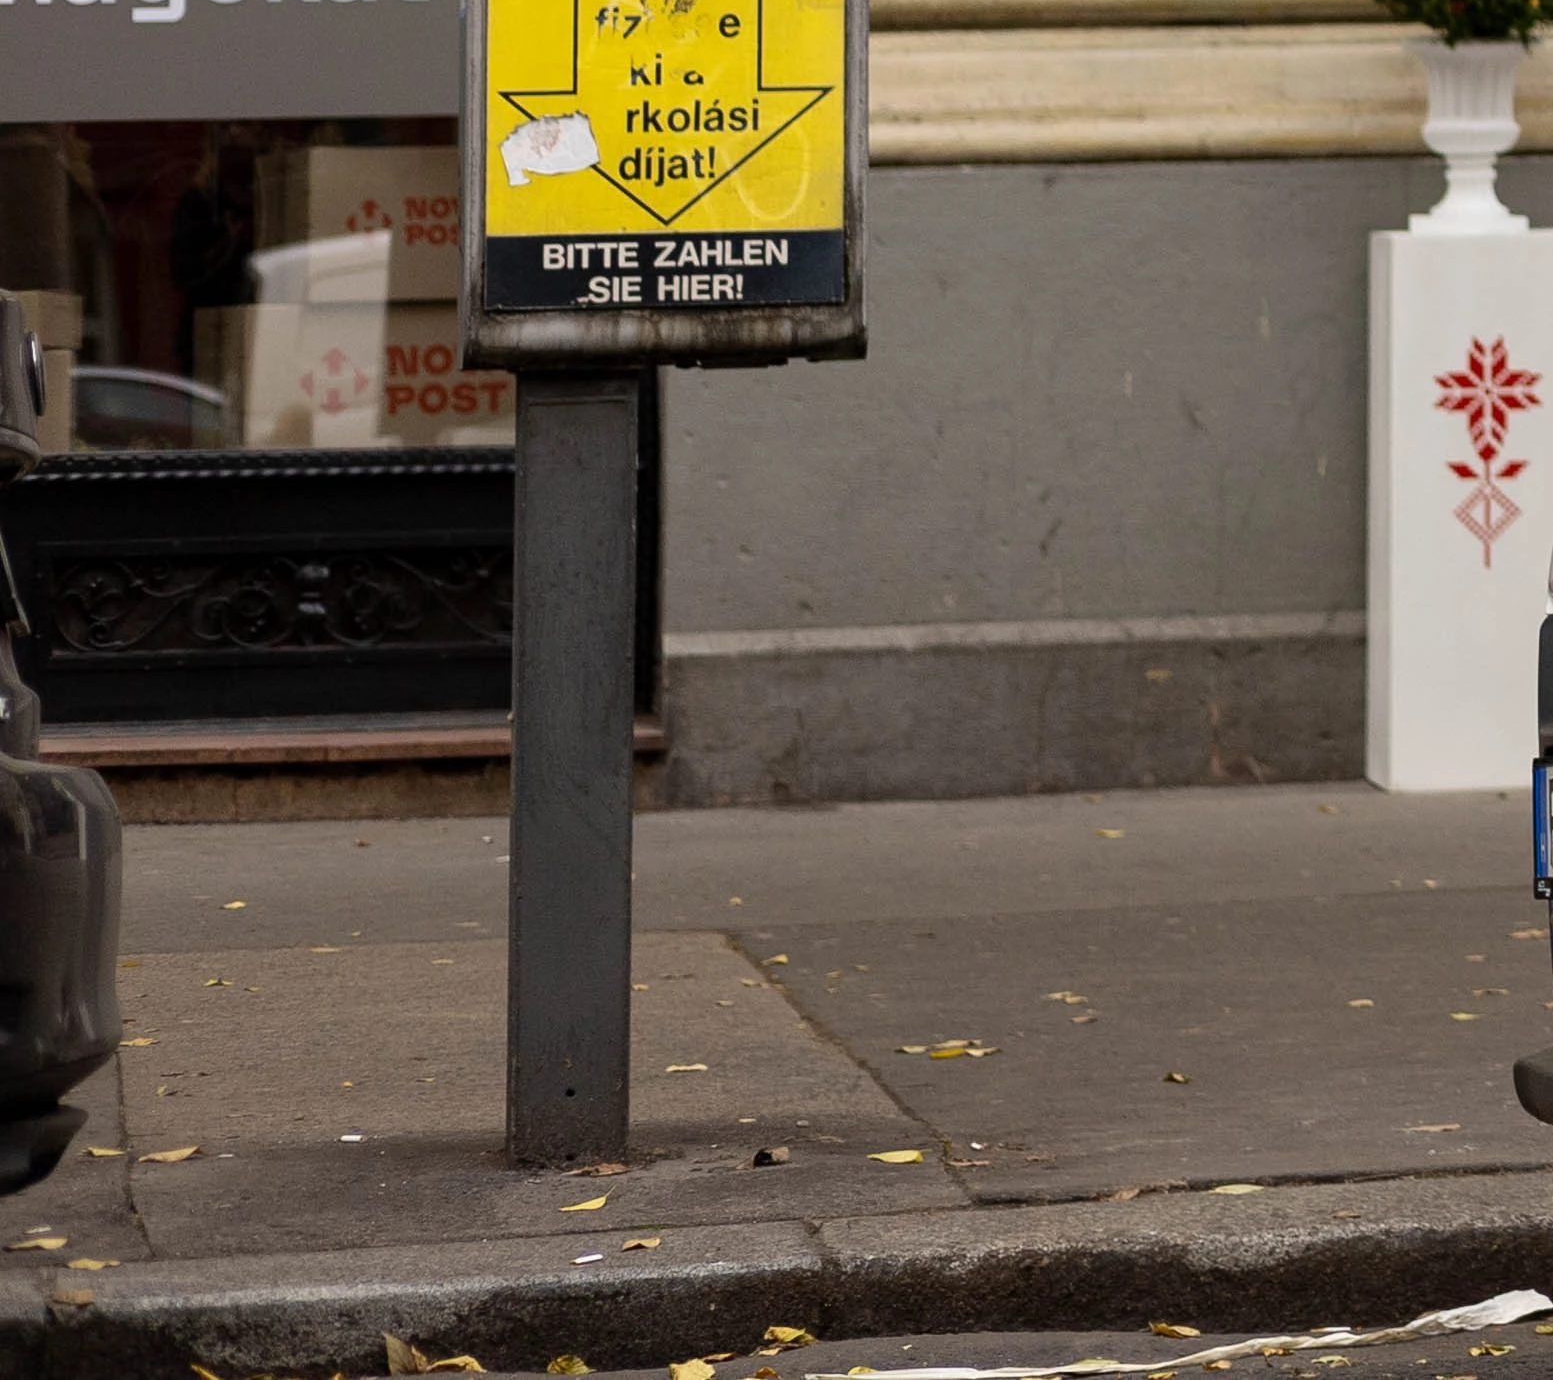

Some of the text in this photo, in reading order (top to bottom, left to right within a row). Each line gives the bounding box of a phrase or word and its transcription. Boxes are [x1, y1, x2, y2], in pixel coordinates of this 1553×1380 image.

[618, 147, 717, 187] díjat!
[543, 239, 789, 270] BITTE ZAHLEN
[588, 274, 744, 304] SIE HIER!
[385, 381, 507, 416] POST
